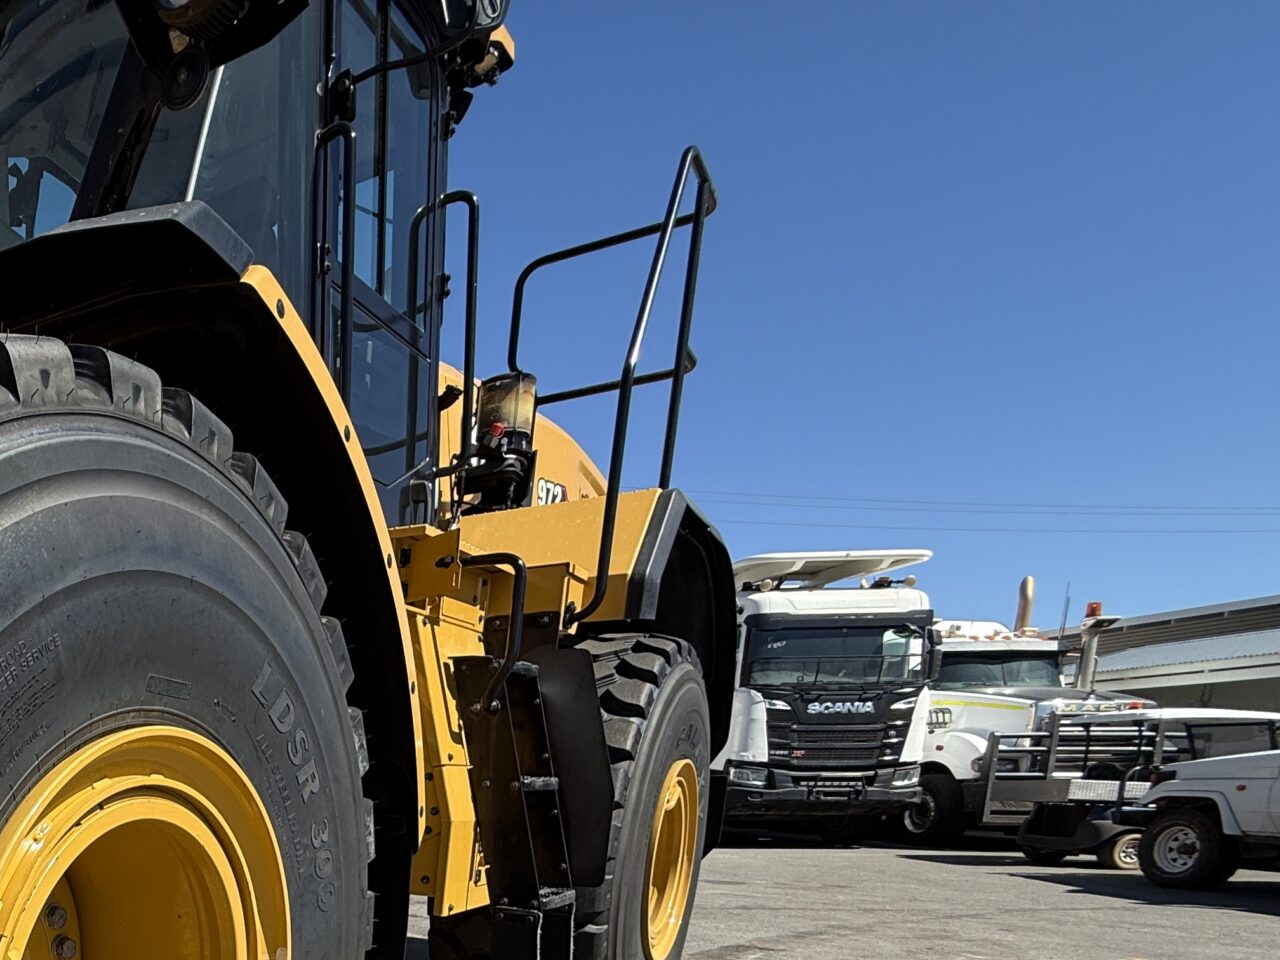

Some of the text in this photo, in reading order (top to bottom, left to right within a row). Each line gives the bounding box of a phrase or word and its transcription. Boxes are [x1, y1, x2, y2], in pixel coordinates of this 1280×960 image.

[538, 478, 562, 505] 972
[0, 640, 27, 673] ROAD
[20, 632, 61, 673] SERVICE
[807, 701, 876, 714] SCANIA
[250, 661, 320, 805] LDSR
[311, 816, 336, 913] 300
